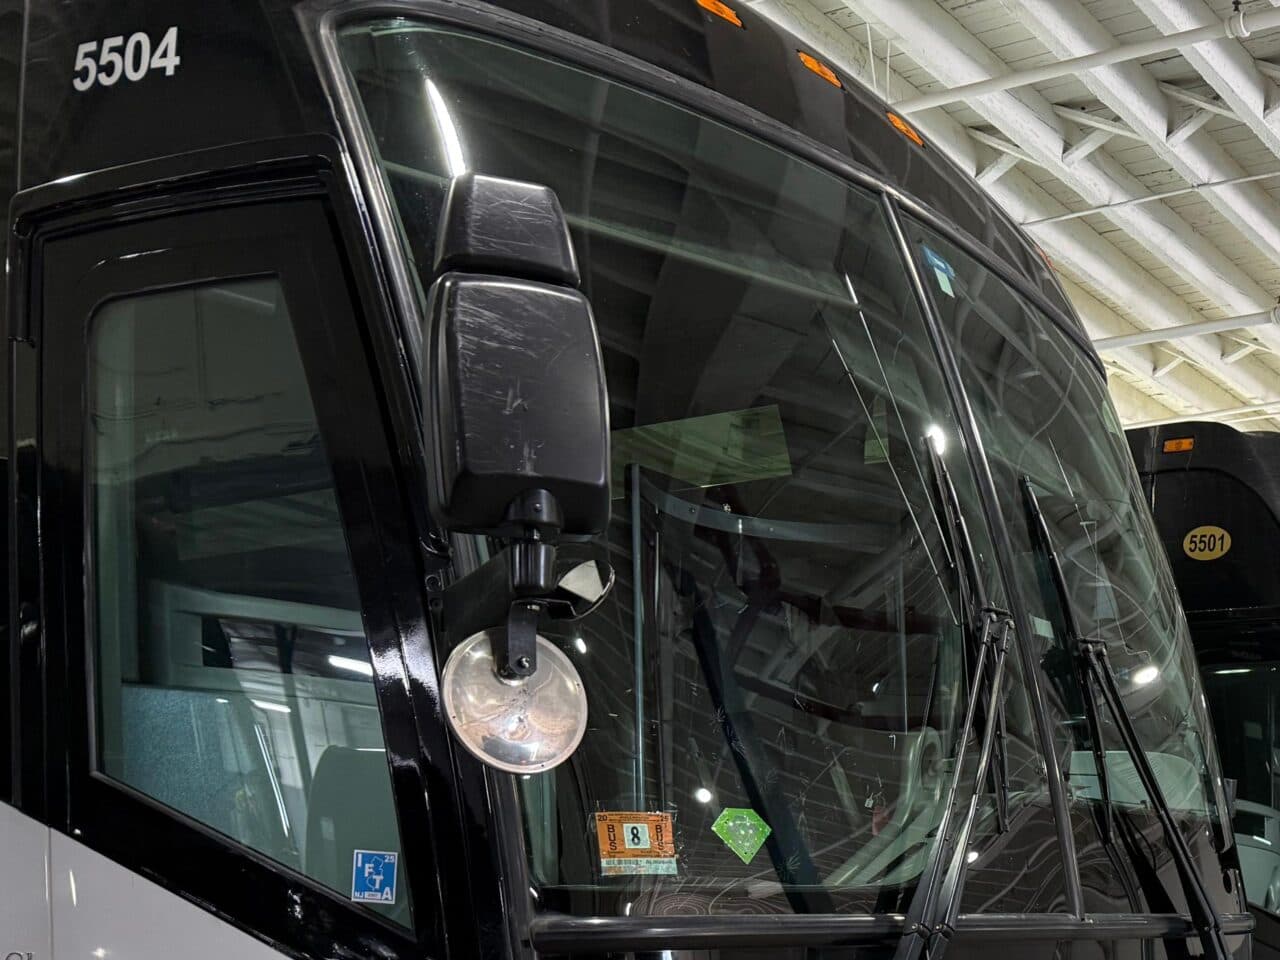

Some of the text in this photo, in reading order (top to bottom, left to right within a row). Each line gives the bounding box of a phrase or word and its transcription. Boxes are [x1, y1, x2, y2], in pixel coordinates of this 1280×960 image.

[73, 26, 180, 91] 5504
[1189, 534, 1224, 552] 5501
[607, 824, 617, 850] BUS
[631, 826, 640, 845] 8
[656, 824, 665, 850] BUS
